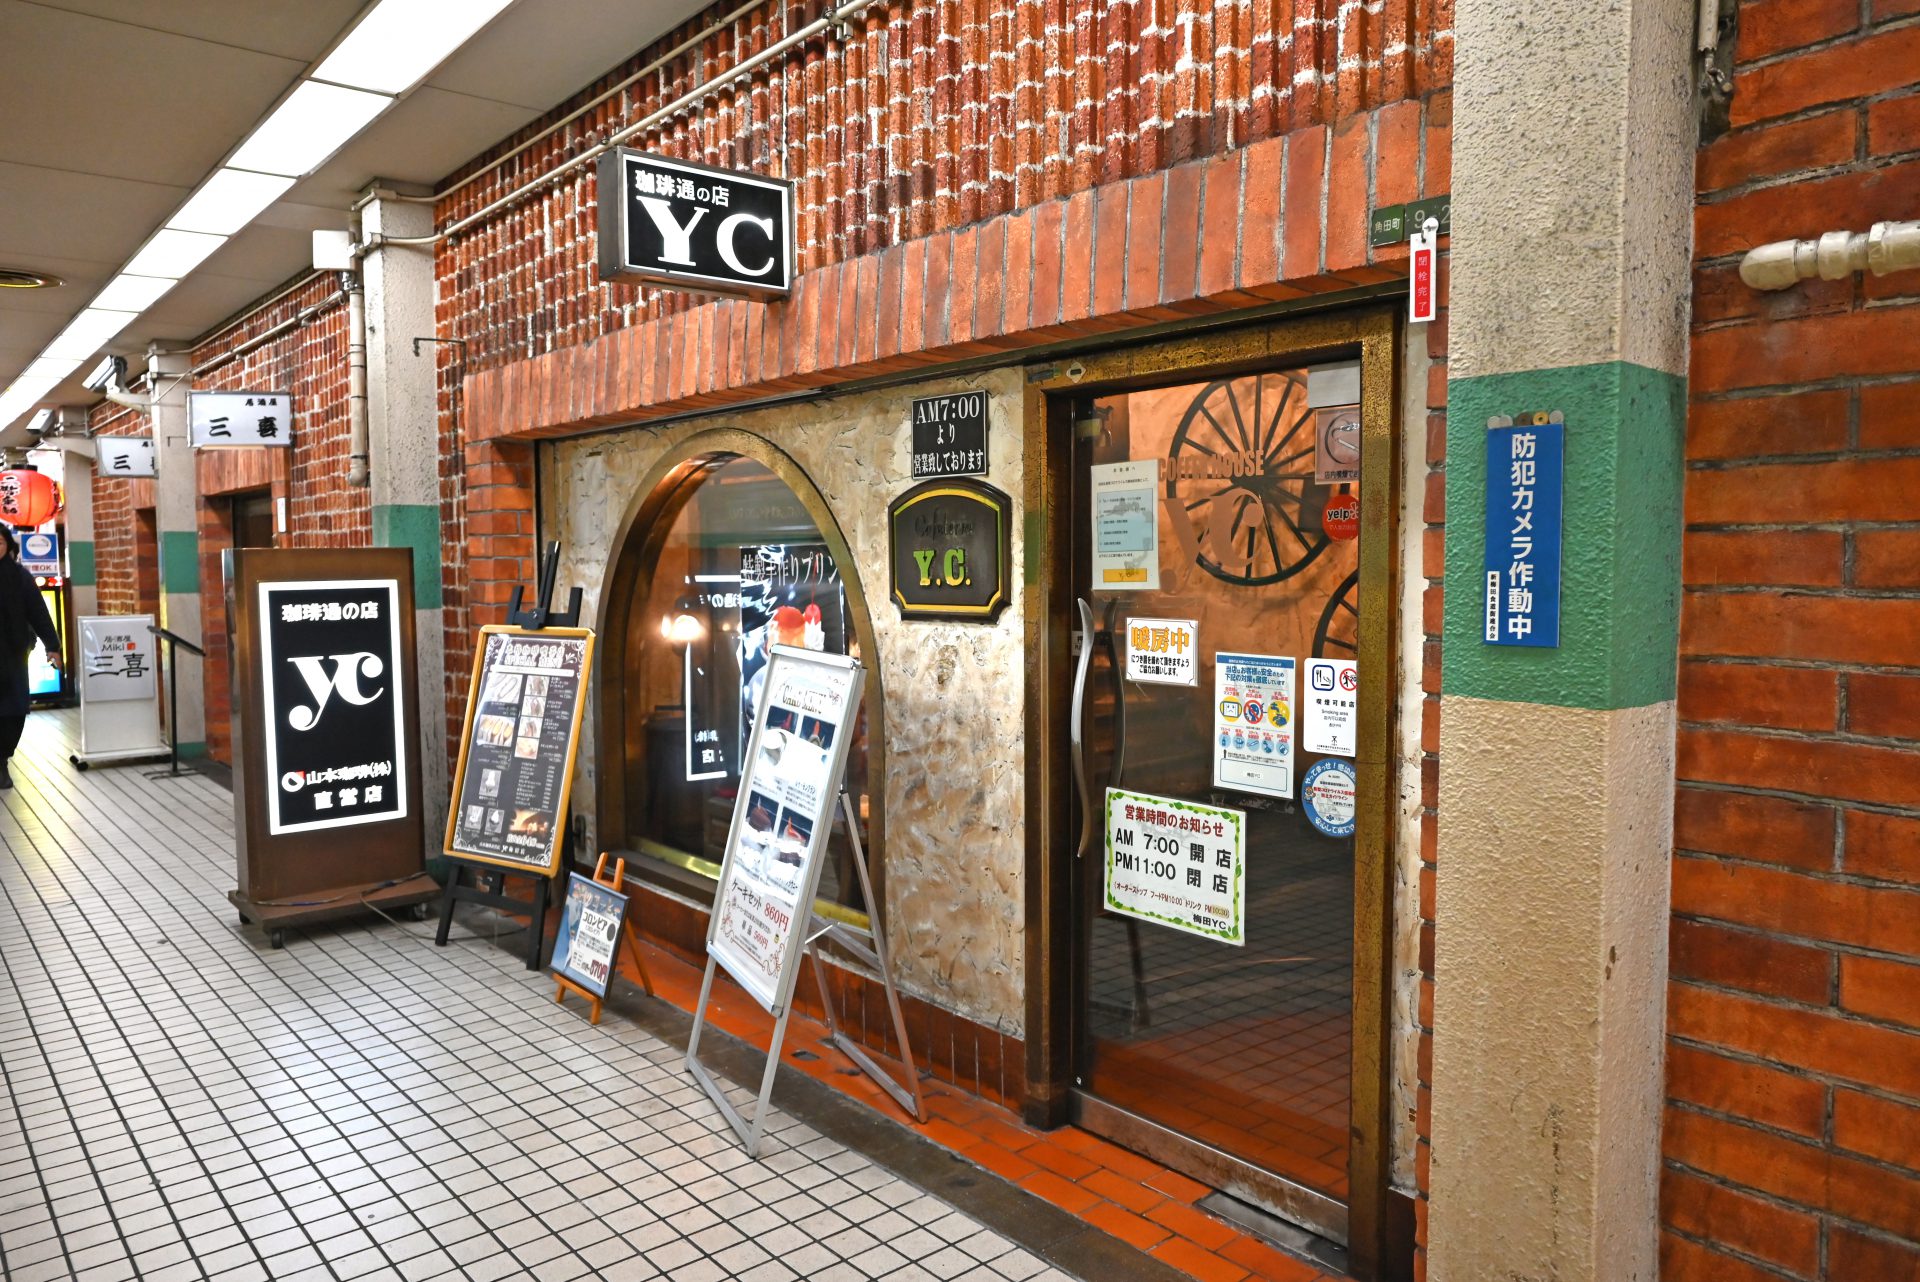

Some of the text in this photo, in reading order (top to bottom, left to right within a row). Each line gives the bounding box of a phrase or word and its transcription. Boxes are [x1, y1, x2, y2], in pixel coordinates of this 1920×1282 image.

[635, 169, 729, 207] 珈琲通の店
[636, 195, 775, 276] YC
[1375, 217, 1400, 233] 角田町
[916, 395, 980, 424] AM7:00
[937, 422, 955, 444] より
[914, 448, 984, 475] 営業致しております
[1327, 507, 1350, 521] yelp
[1508, 432, 1536, 640] 防犯カメラ作動中
[281, 601, 378, 622] 珈琲通の店
[101, 643, 125, 652] Miki
[1131, 626, 1190, 654] 暖房中
[89, 653, 149, 678] 三喜
[314, 785, 383, 810] 直営店
[1125, 804, 1224, 837] 営業時間のお知らせ
[1115, 828, 1134, 846] AM
[1143, 833, 1179, 856] 7:00
[732, 878, 762, 911] ケーキセット
[764, 902, 789, 933] 860円
[1193, 913, 1227, 930] 梅田YC
